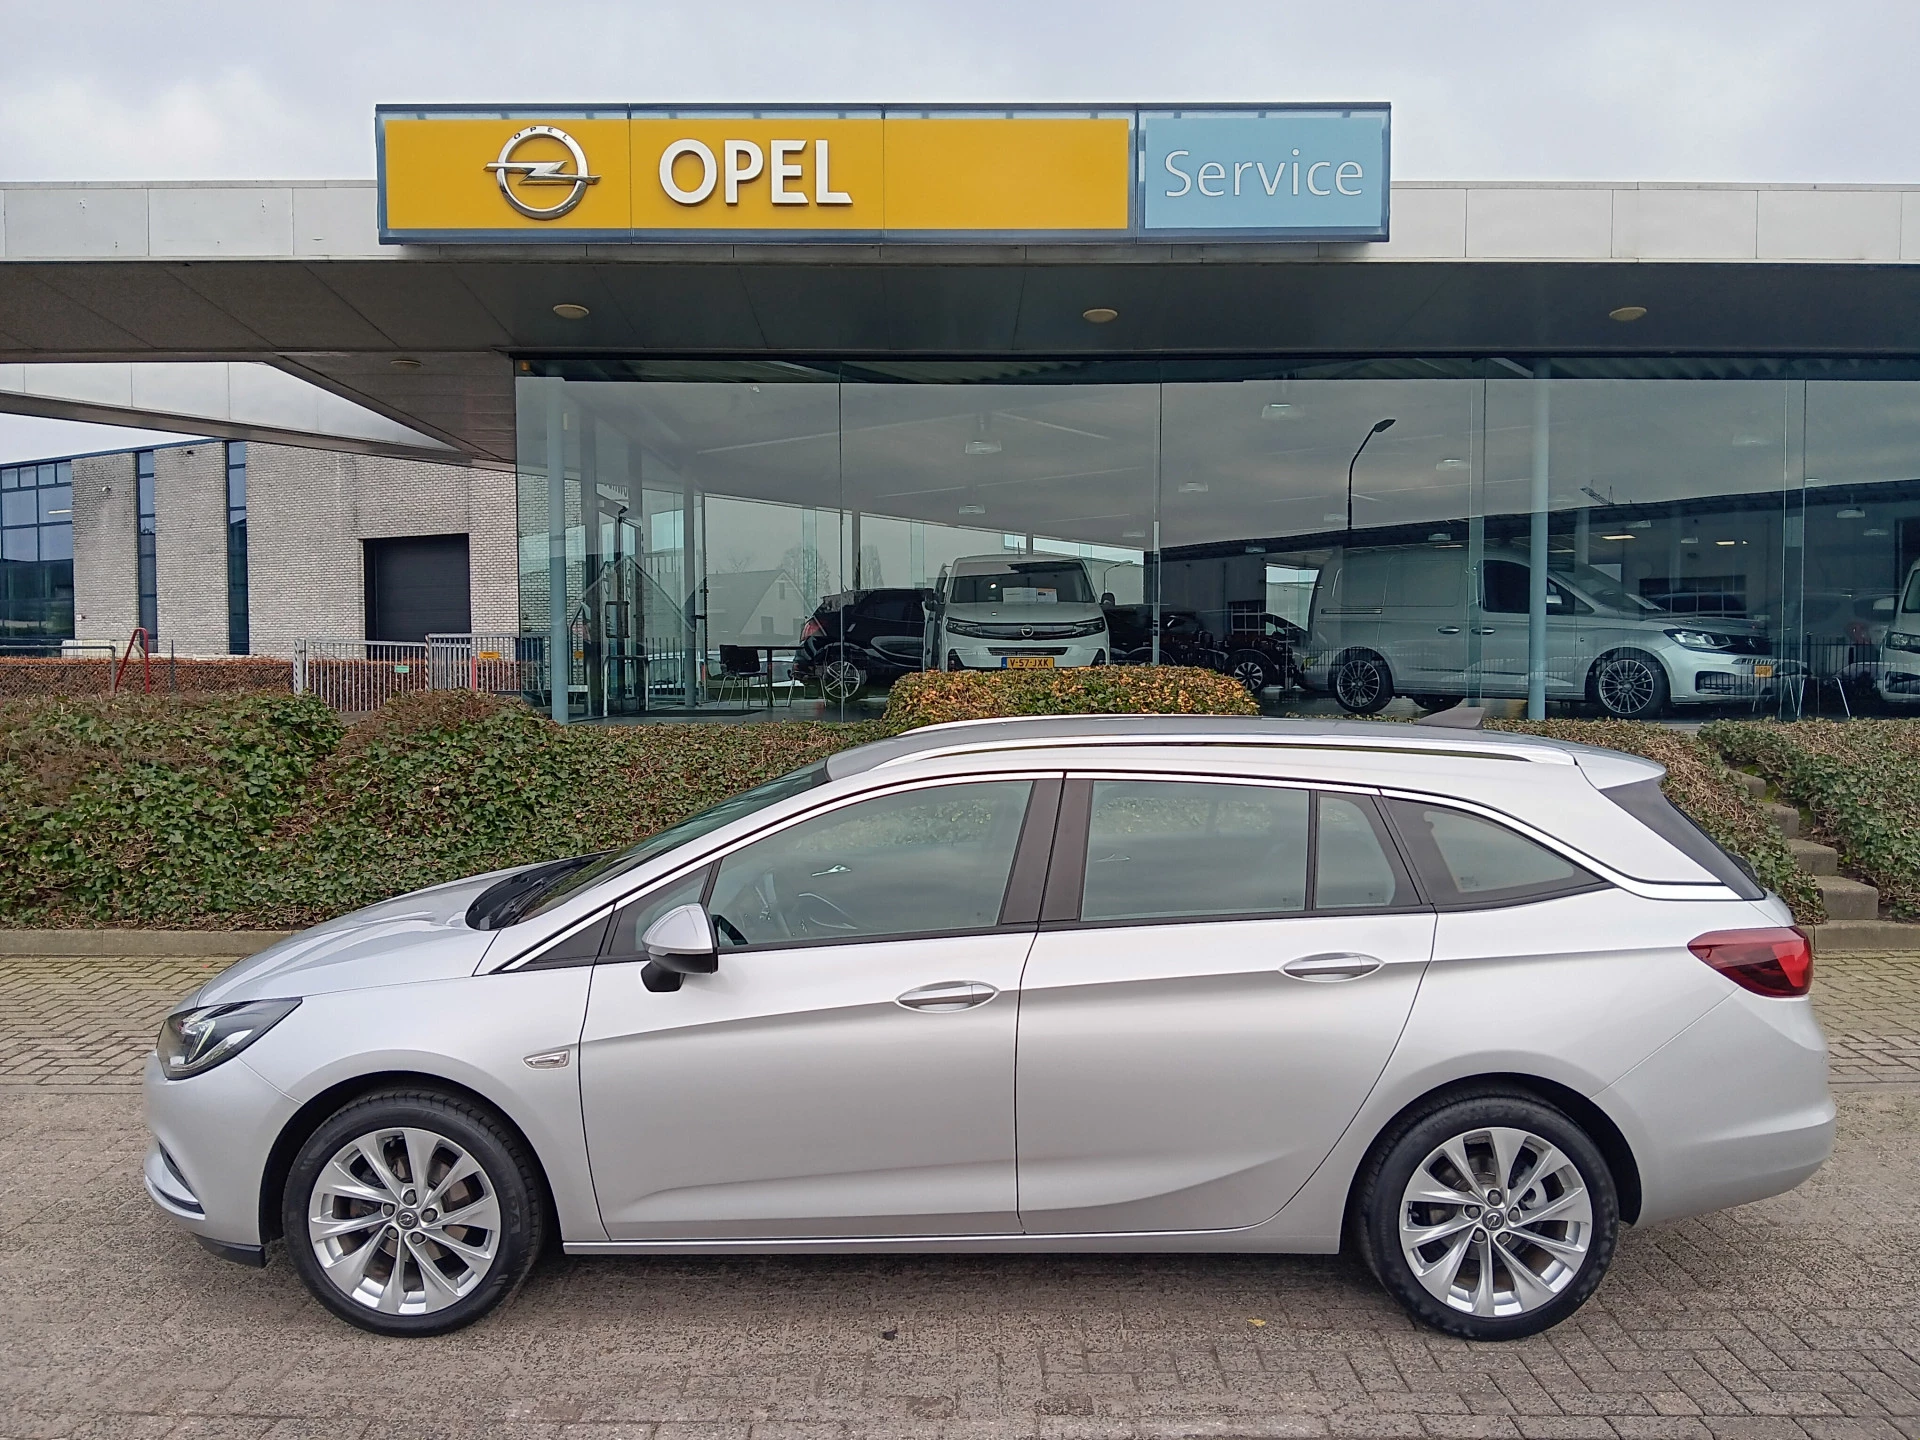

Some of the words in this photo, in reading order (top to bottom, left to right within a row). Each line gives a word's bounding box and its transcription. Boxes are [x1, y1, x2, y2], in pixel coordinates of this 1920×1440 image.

[513, 126, 568, 141] OPEL
[658, 138, 853, 207] OPEL
[1164, 148, 1364, 198] Service
[1009, 658, 1049, 667] V-57-JXK
